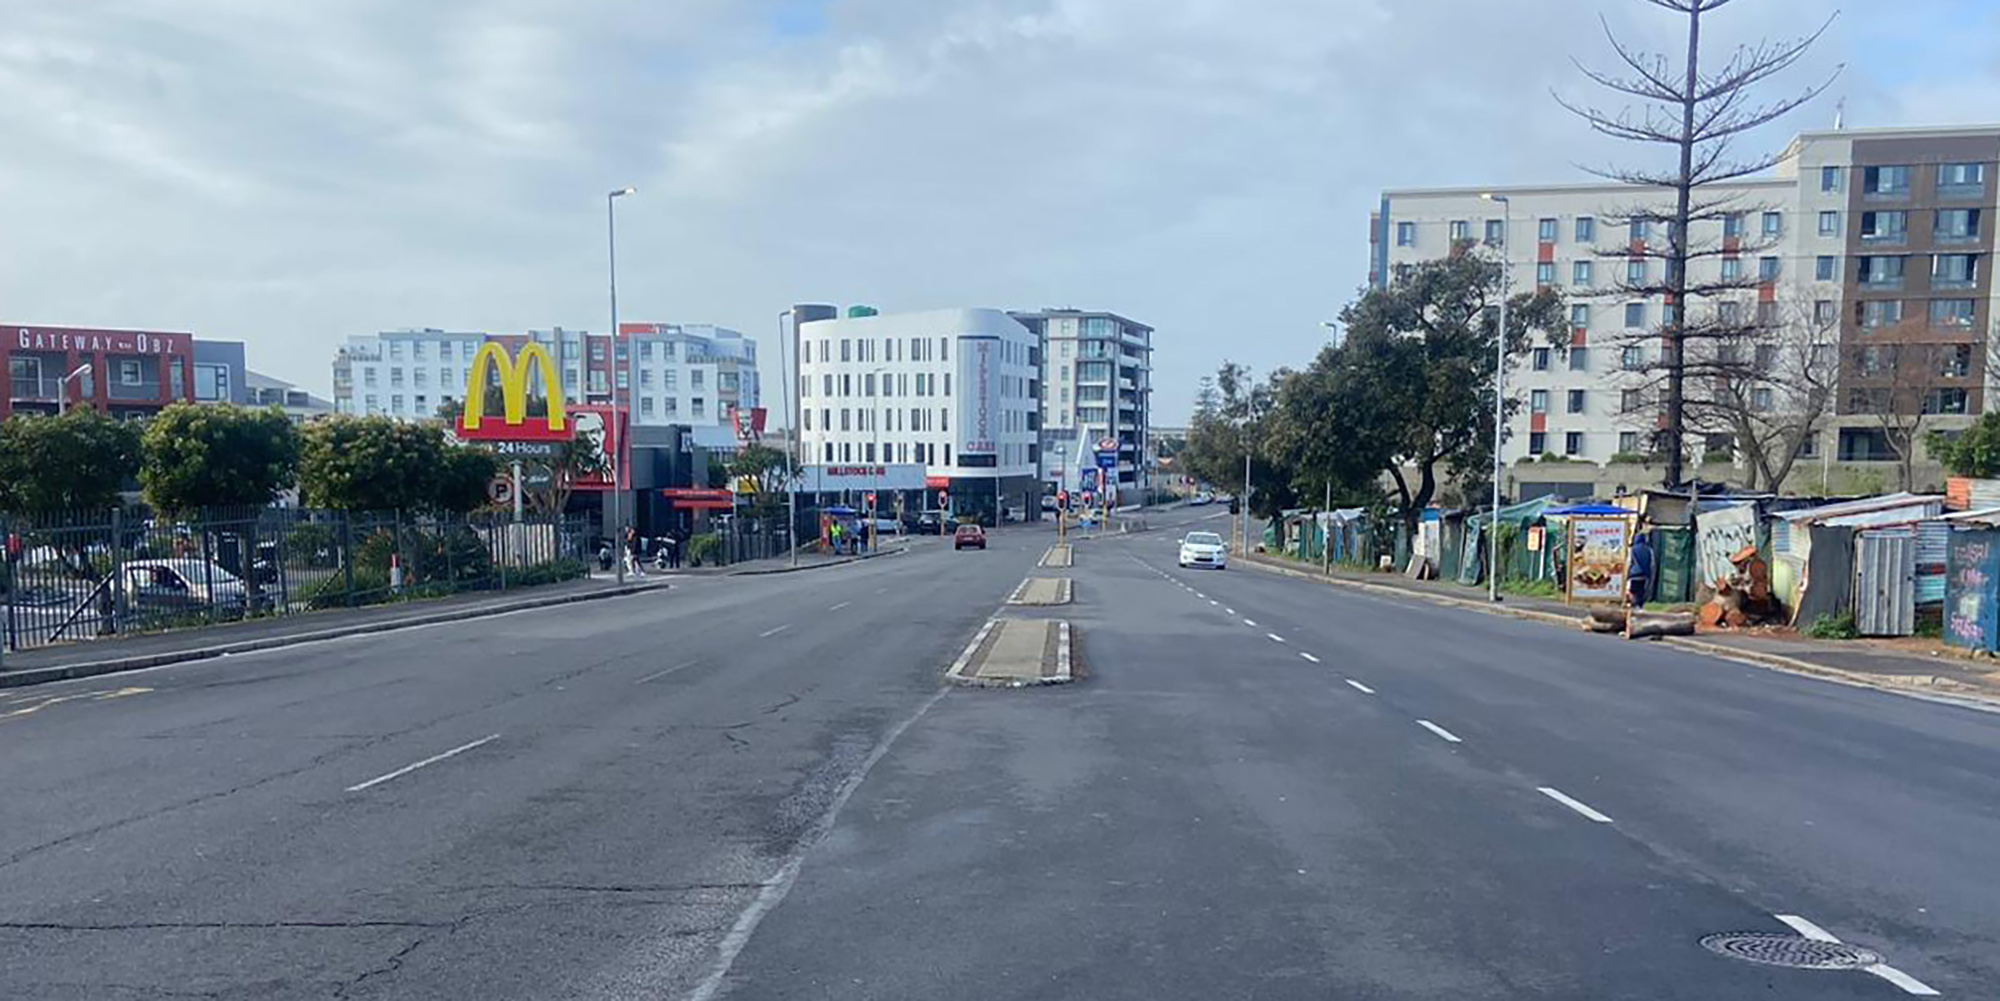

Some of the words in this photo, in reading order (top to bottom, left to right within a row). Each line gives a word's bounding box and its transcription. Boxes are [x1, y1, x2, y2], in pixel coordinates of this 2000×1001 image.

[19, 328, 112, 350] GATEWAY
[498, 442, 514, 454] 24
[515, 442, 551, 454] Hours
[496, 484, 507, 498] P
